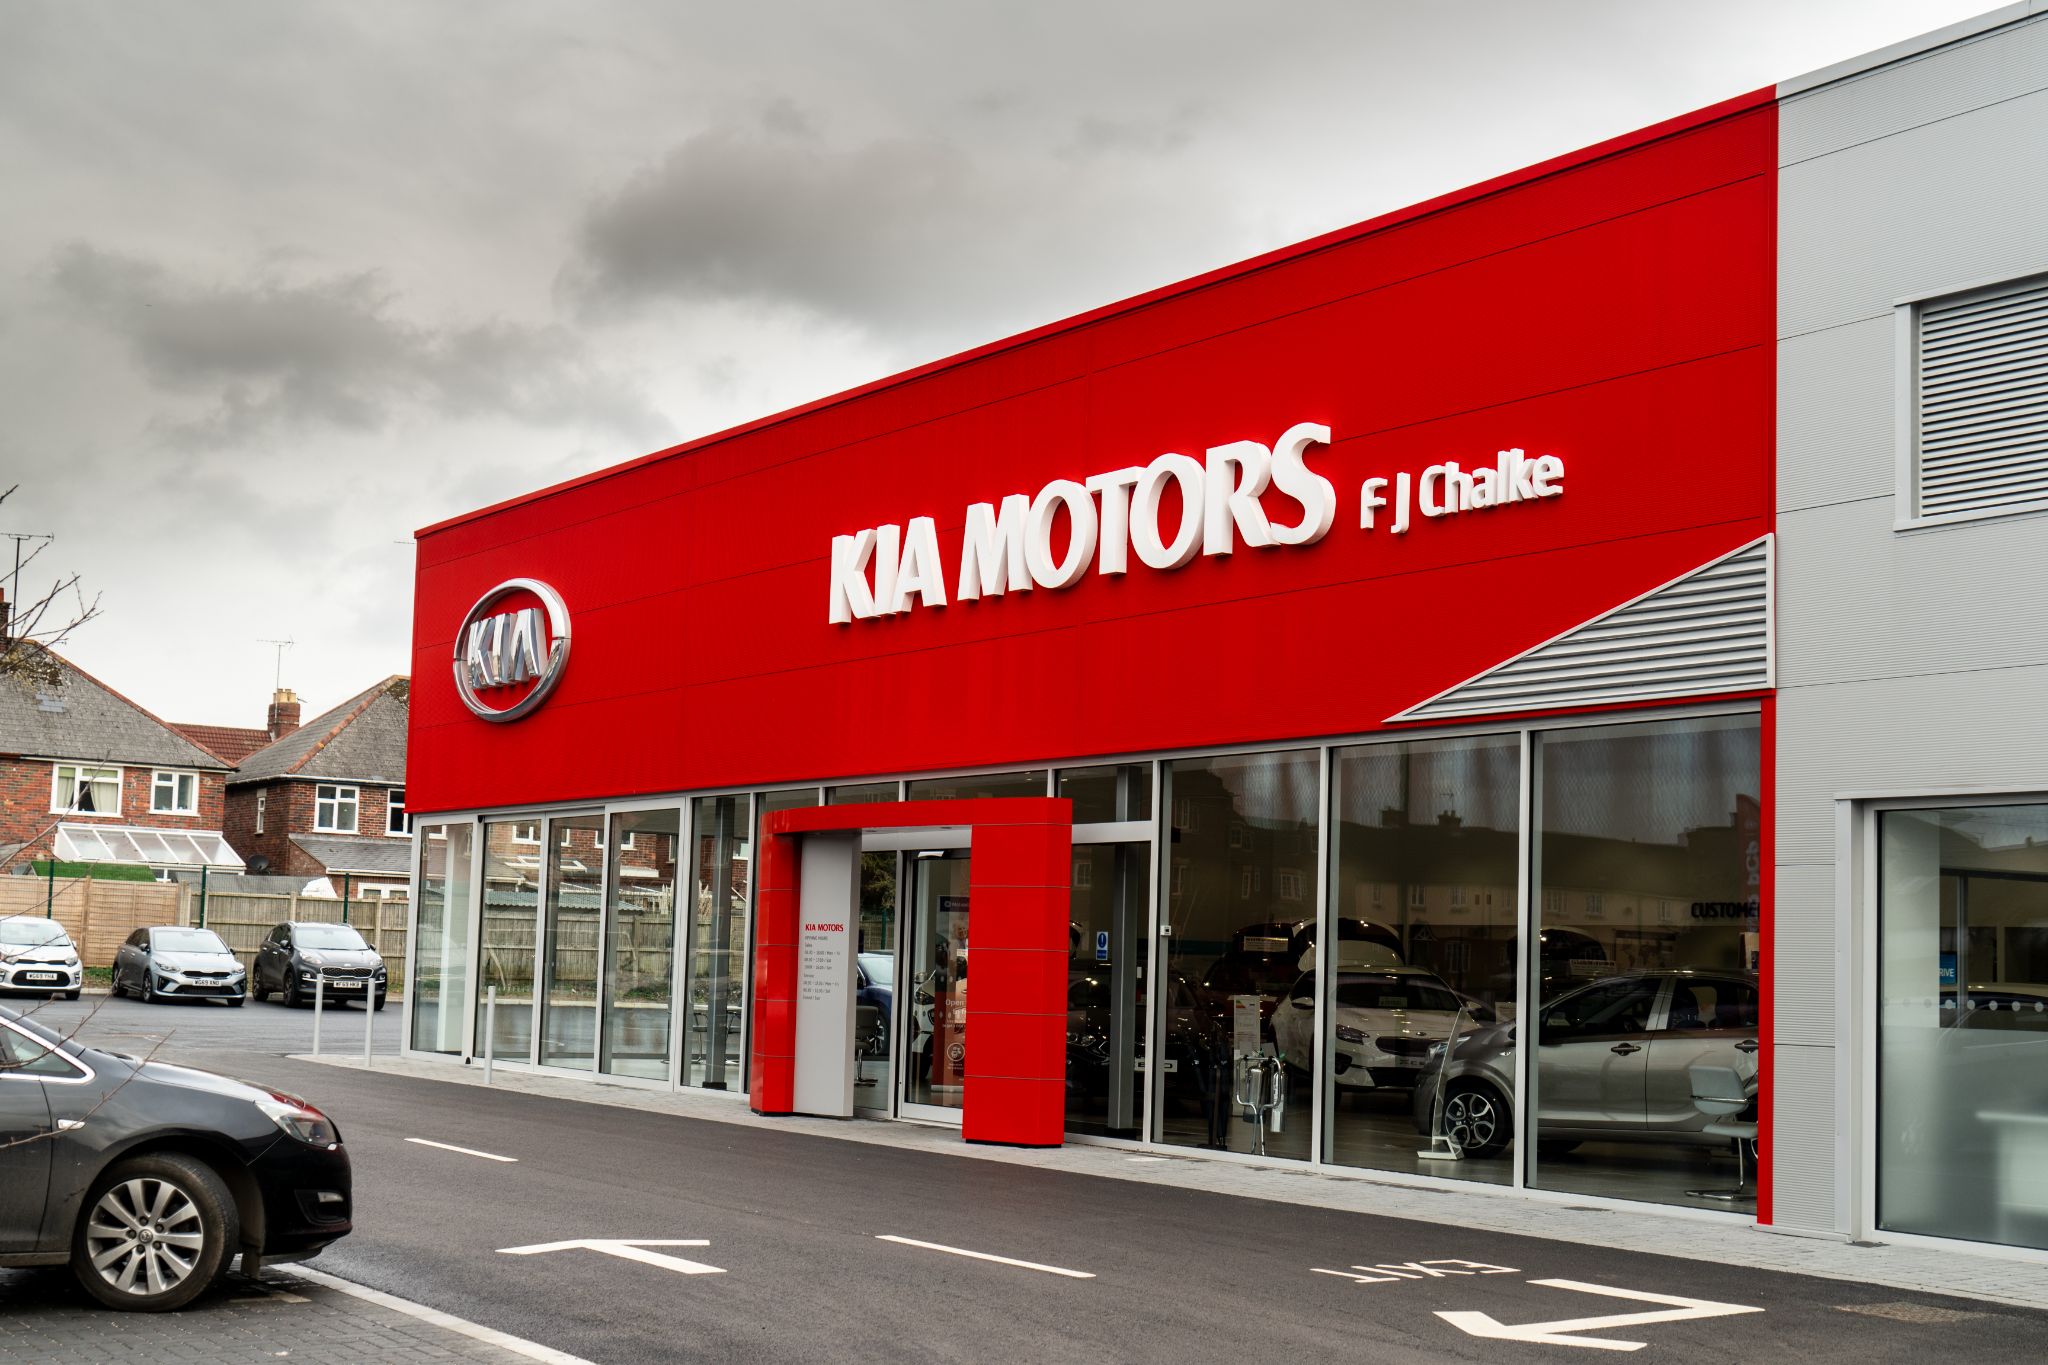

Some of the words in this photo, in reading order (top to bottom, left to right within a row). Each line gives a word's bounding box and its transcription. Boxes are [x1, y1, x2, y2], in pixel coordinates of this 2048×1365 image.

[829, 516, 947, 624] KIA
[957, 422, 1337, 602] MOTORS
[1360, 477, 1388, 529] F
[1391, 472, 1411, 533] J
[1419, 448, 1565, 517] Chalke
[466, 607, 550, 690] KIA
[805, 923, 816, 931] KIA
[818, 923, 844, 932] MOTORS
[1691, 902, 1760, 917] CUSTOME
